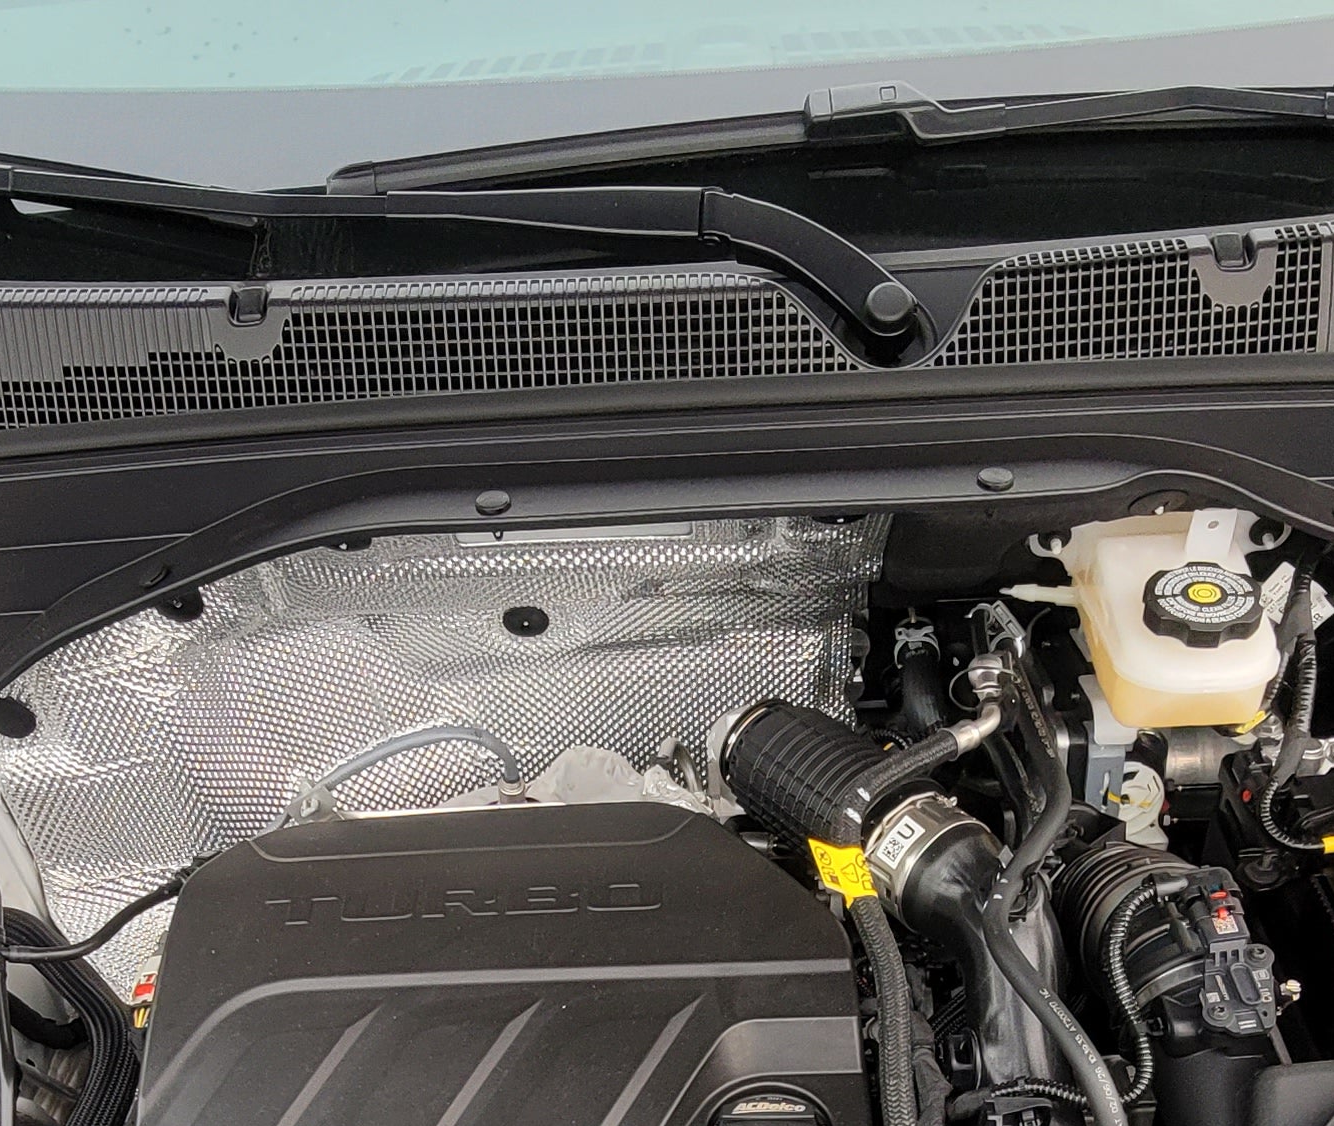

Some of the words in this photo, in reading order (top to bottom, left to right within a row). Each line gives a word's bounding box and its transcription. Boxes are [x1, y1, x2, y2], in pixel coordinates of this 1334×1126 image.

[897, 823, 915, 840] U
[263, 881, 663, 928] TURBO
[732, 1102, 807, 1115] ACDelco
